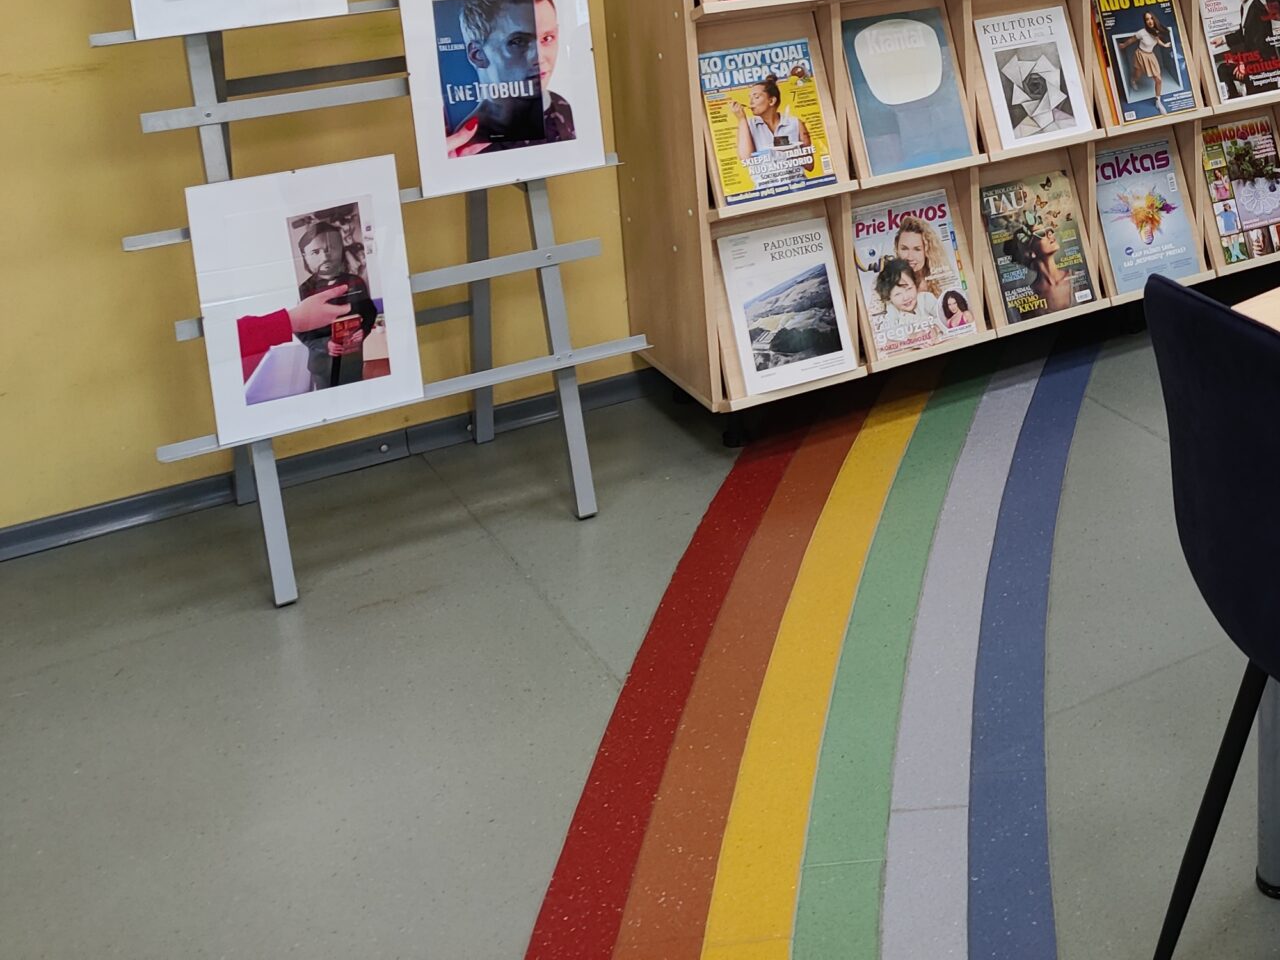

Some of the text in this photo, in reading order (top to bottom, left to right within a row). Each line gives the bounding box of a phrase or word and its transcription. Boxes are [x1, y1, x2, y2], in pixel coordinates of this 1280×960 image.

[982, 14, 1053, 35] KULTŪROS
[990, 30, 1033, 45] BARAI
[700, 44, 804, 75] KO GYDYTOJAI
[703, 70, 731, 89] TAU
[446, 80, 534, 105] [NE]TOBULI
[984, 190, 1025, 217] TAU
[855, 218, 886, 238] Prie
[763, 231, 821, 251] PADUBYSIO
[770, 243, 824, 262] KRONIKOS
